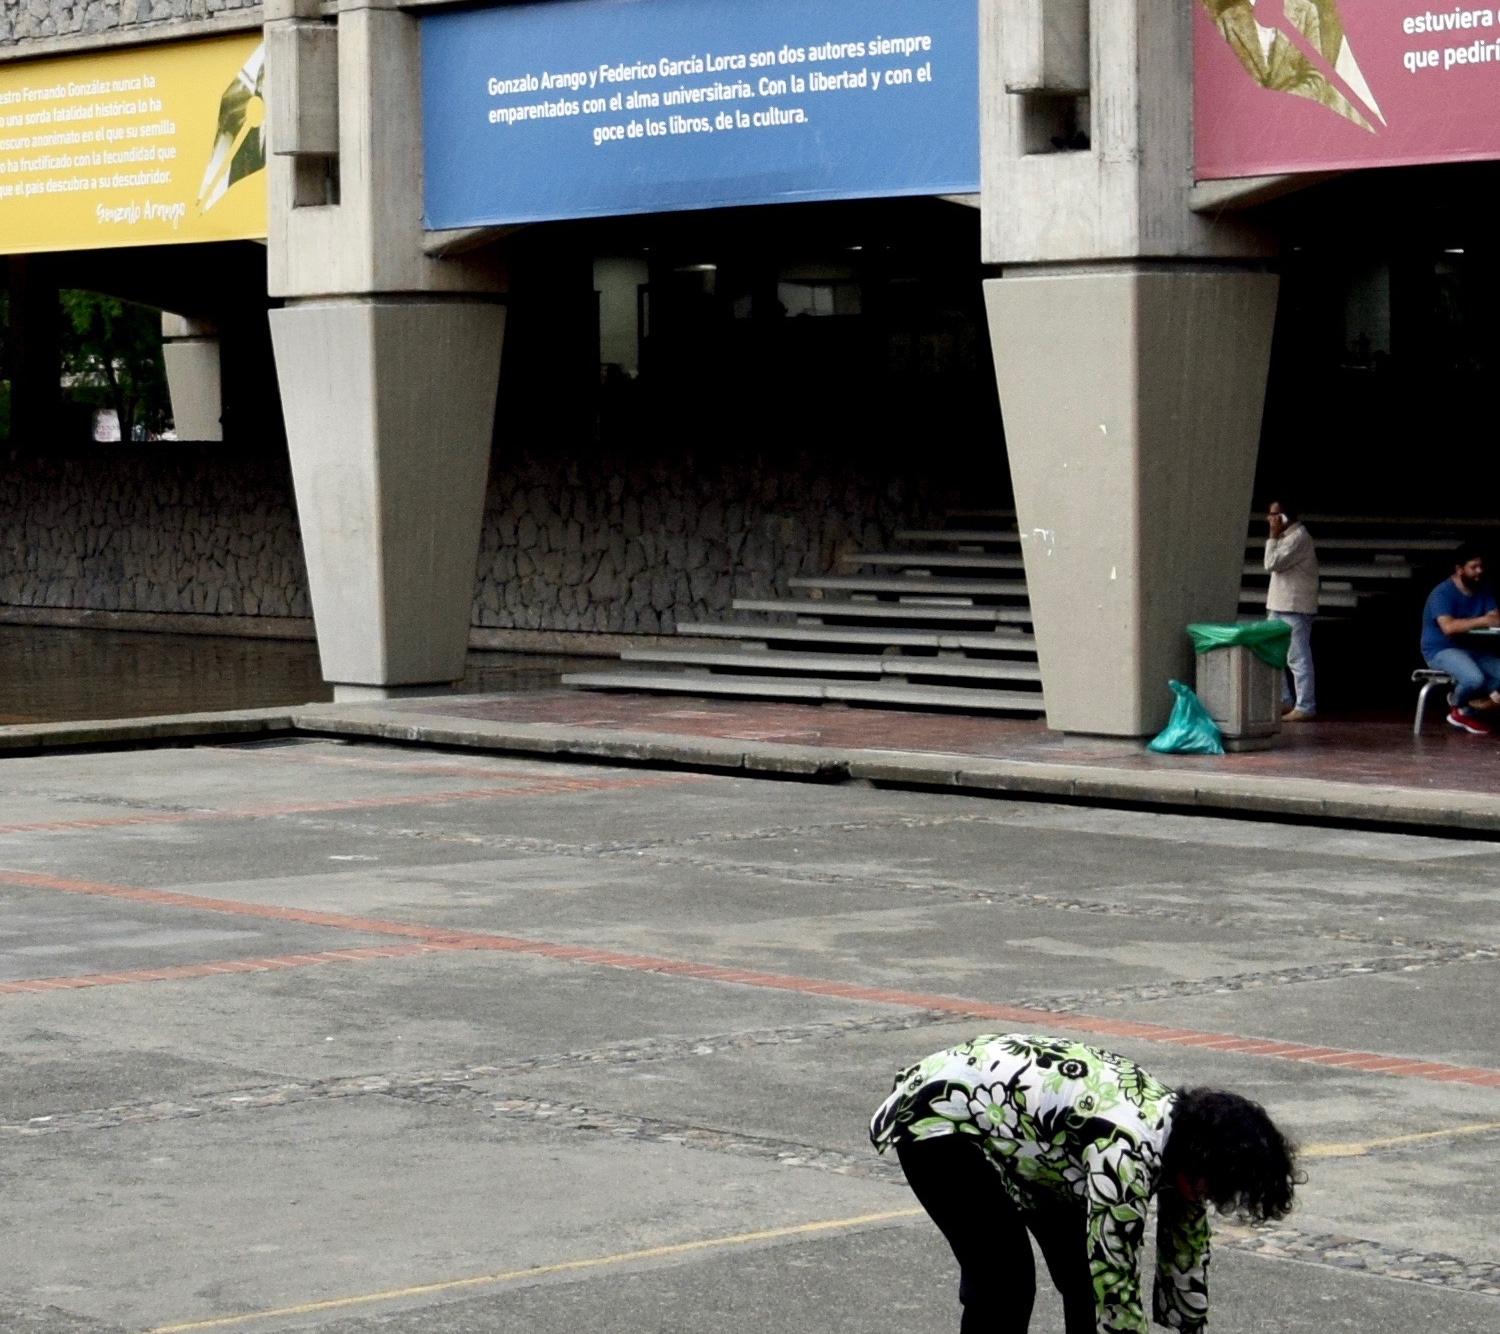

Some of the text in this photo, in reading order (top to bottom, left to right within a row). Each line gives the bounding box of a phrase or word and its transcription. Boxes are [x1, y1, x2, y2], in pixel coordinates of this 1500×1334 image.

[1404, 7, 1492, 34] estuviera
[488, 36, 931, 95] Gonzalo Arango y Federico García Lorca son dos autores siempre
[1404, 50, 1439, 73] que
[144, 74, 155, 88] ha
[139, 99, 147, 112] lo
[150, 98, 161, 111] ha
[489, 62, 932, 125] emparentados con el alma universitaria. Con la libertad y con el
[82, 131, 93, 142] en
[96, 128, 104, 141] el
[107, 129, 124, 142] que
[127, 128, 137, 137] su
[594, 107, 808, 146] goce de los libros, de la cultura.
[8, 160, 18, 172] ha
[93, 152, 101, 164] la
[158, 148, 176, 161] que
[15, 182, 24, 195] el
[91, 179, 97, 188] a
[100, 178, 110, 188] su
